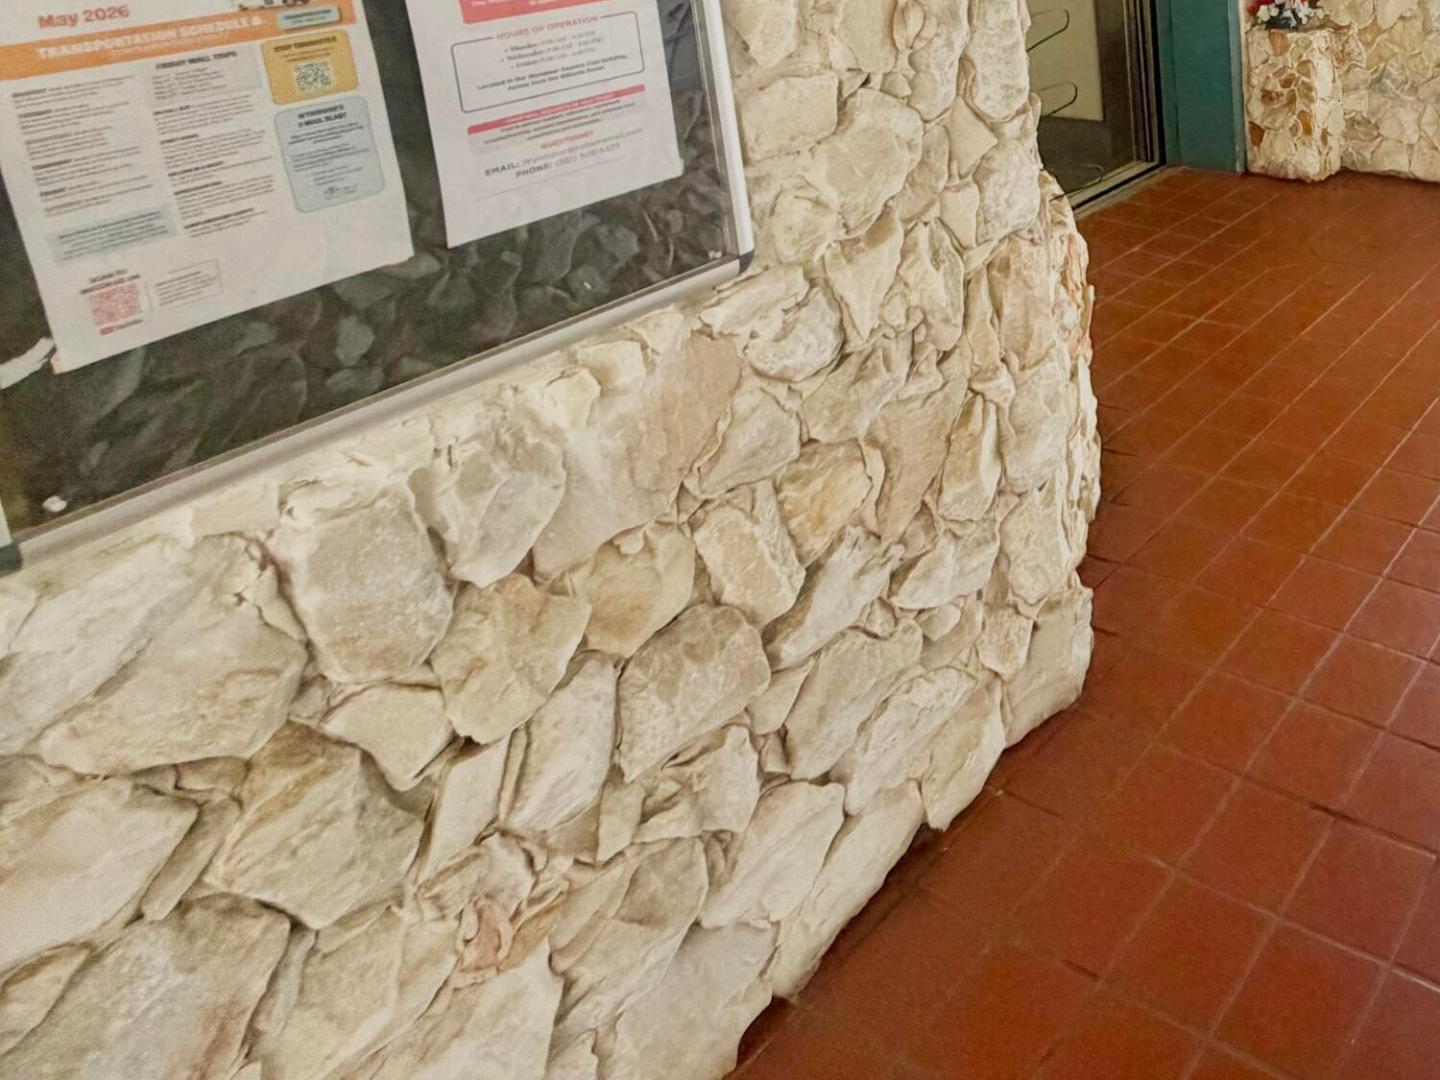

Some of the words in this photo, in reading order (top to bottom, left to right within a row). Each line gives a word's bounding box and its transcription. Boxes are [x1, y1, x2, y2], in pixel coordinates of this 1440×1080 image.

[38, 13, 78, 29] May
[83, 5, 130, 23] 2026
[496, 27, 529, 41] HOURS
[531, 24, 544, 35] OF
[546, 15, 599, 32] OPERATION
[484, 161, 521, 177] EMAIL:
[515, 161, 552, 179] PHONE:
